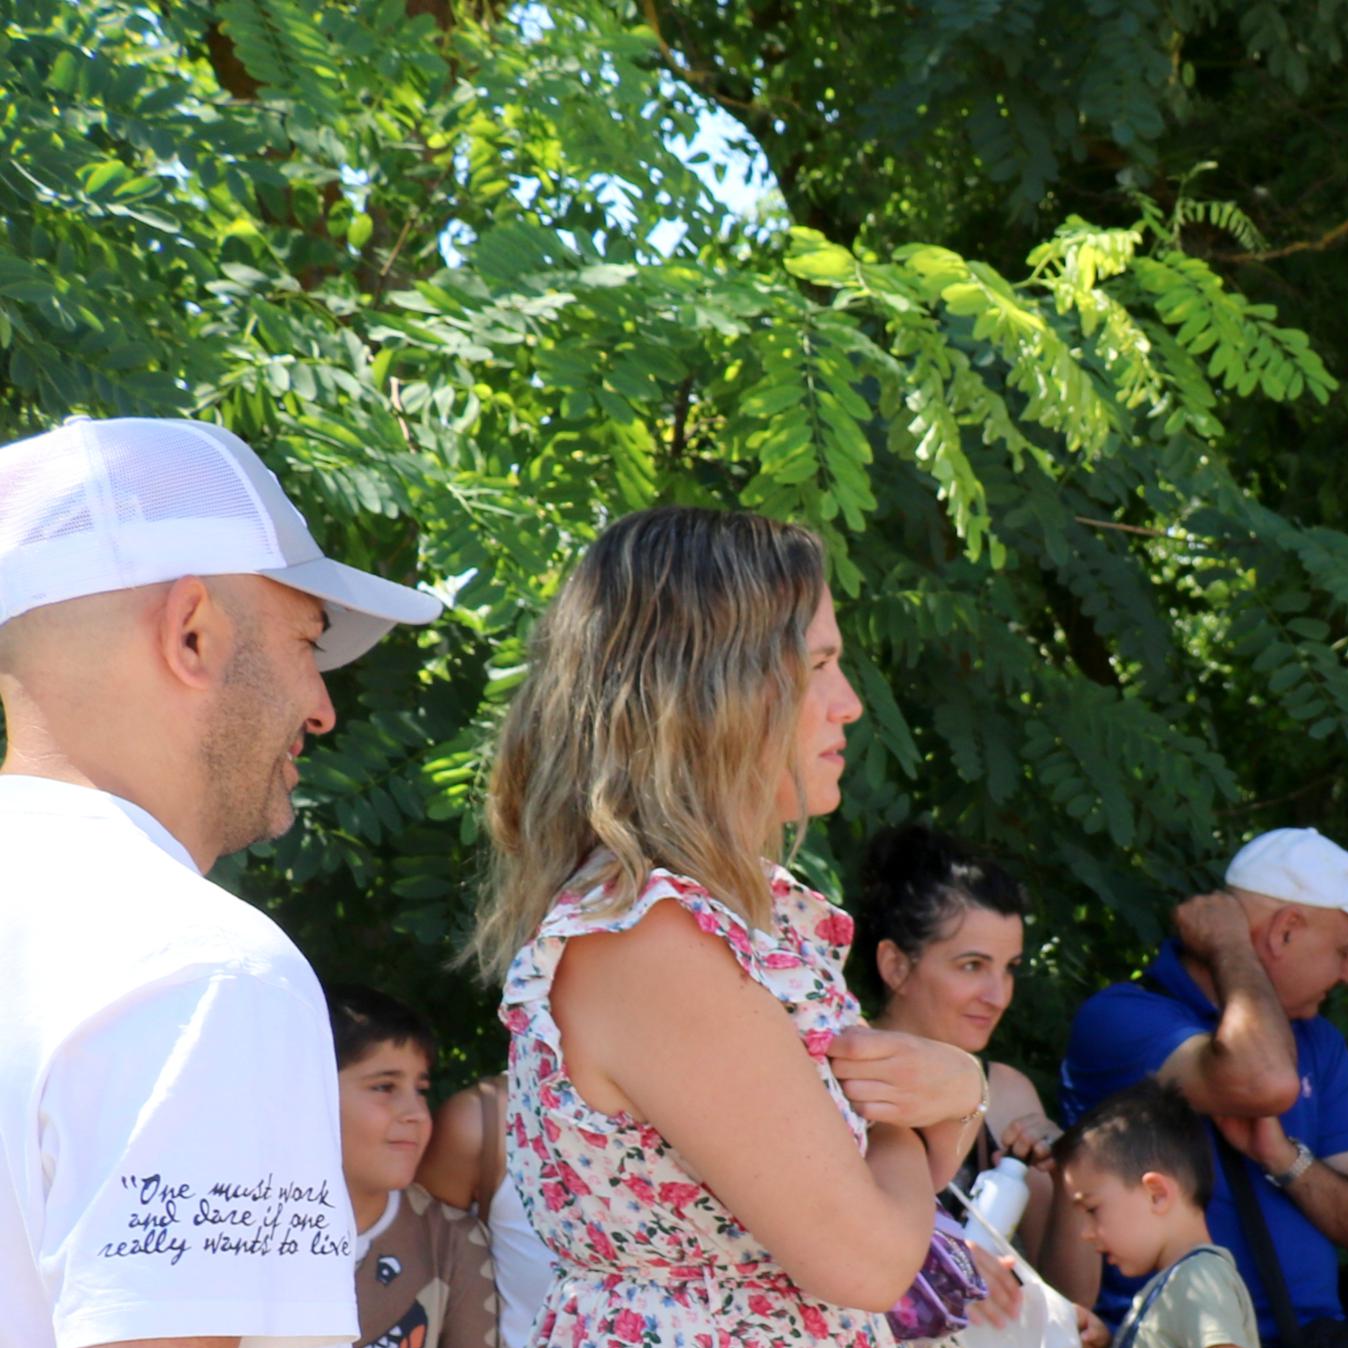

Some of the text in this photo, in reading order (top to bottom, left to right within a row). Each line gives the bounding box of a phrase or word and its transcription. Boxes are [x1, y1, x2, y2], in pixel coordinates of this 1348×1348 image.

[208, 1172, 273, 1202] must
[278, 1179, 336, 1208] work
[128, 1198, 330, 1240] and dare if one
[97, 1228, 192, 1266] really
[203, 1226, 272, 1256] wants
[278, 1228, 299, 1256] to
